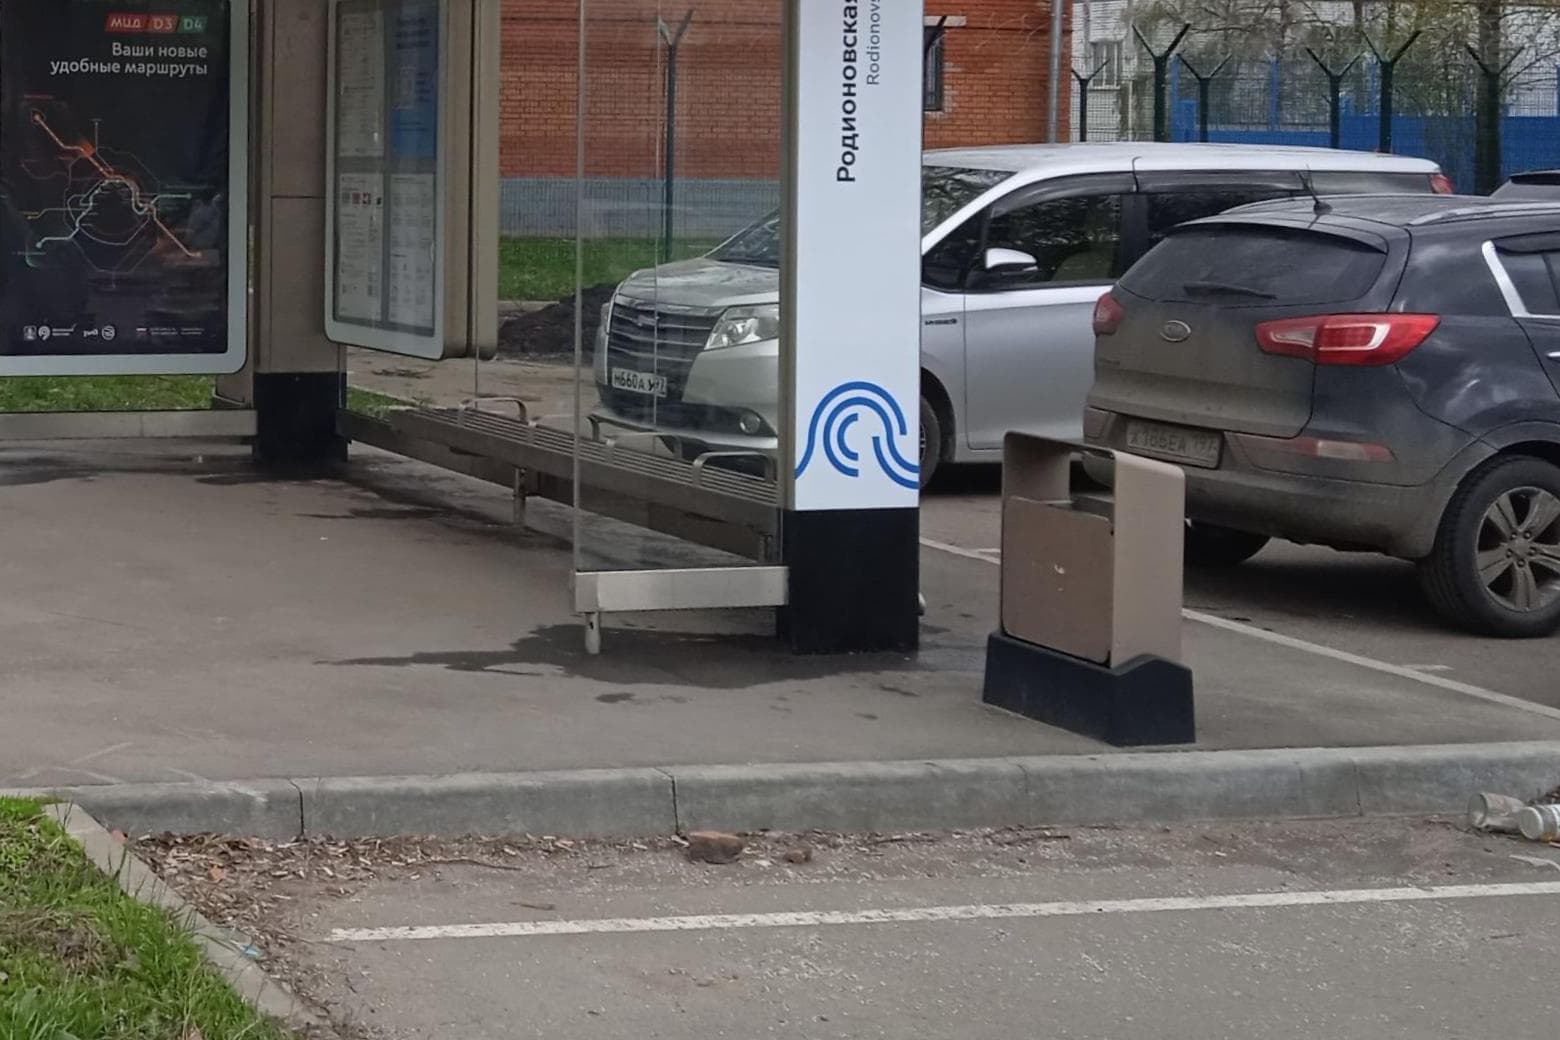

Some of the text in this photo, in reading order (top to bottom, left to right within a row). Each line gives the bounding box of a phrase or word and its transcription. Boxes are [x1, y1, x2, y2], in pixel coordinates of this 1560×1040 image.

[110, 17, 204, 30] МЦД D3 D4
[112, 42, 208, 58] Ваши новые
[50, 58, 208, 77] удобные маршруты
